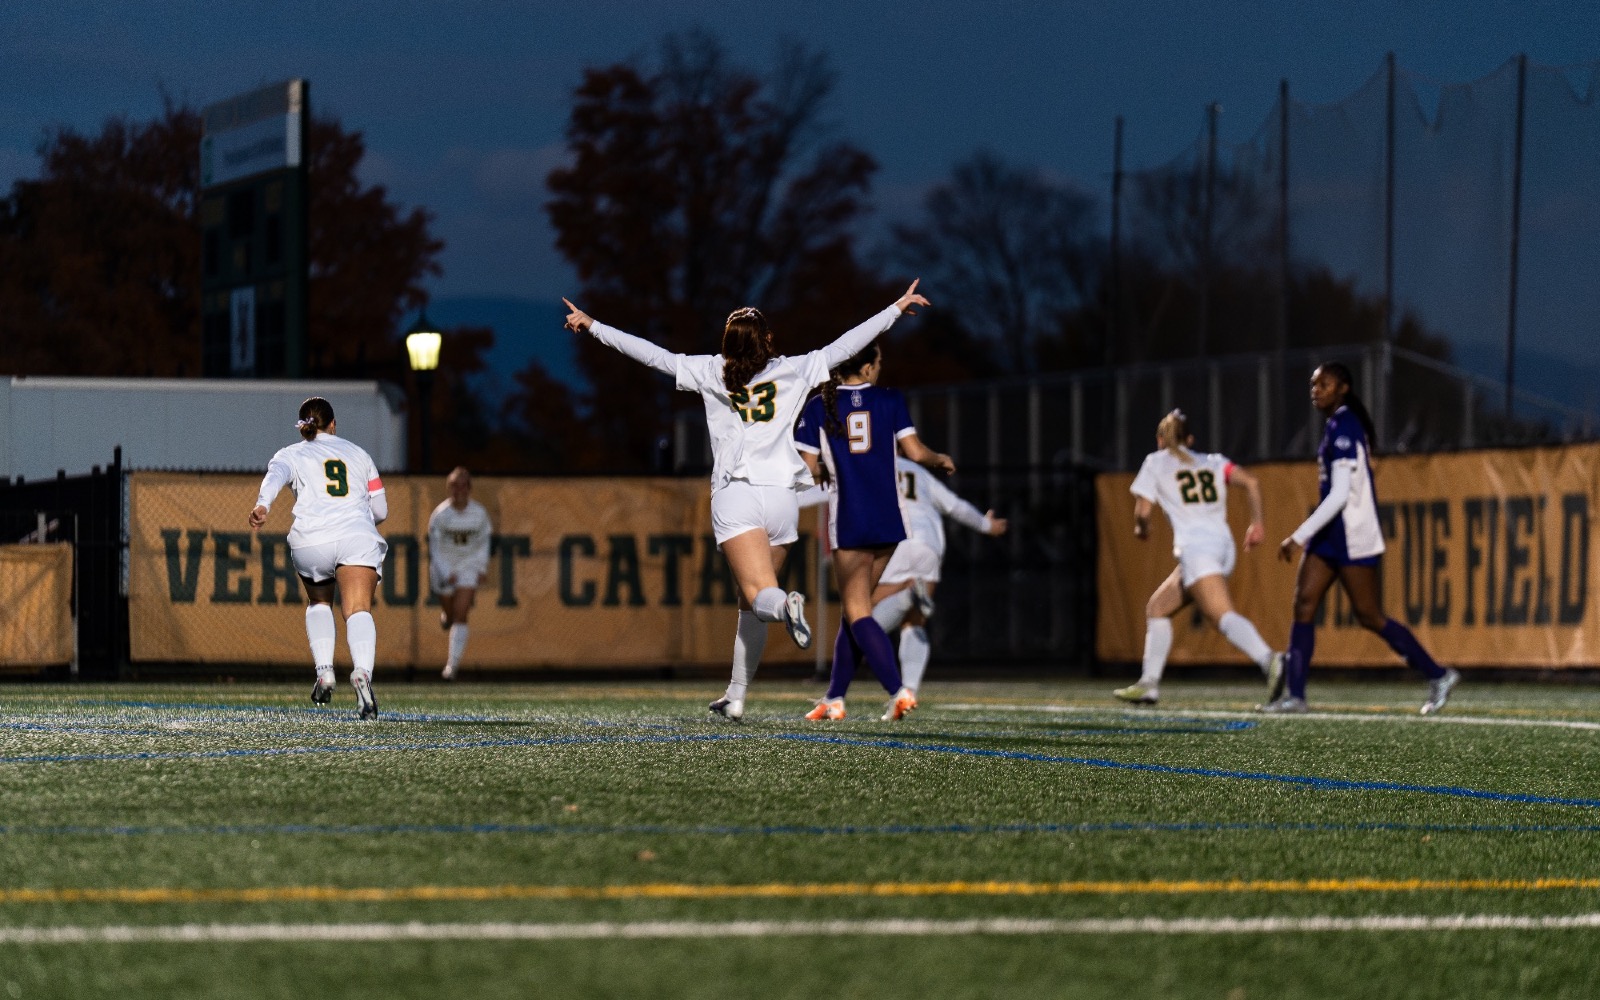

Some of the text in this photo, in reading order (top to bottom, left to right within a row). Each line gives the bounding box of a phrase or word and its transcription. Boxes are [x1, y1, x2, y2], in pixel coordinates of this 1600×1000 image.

[847, 411, 872, 454] 9
[323, 458, 349, 498] 9
[898, 471, 917, 501] 1
[1175, 469, 1218, 503] 28
[160, 529, 841, 606] VEROT CATA
[1463, 493, 1590, 625] FIELD
